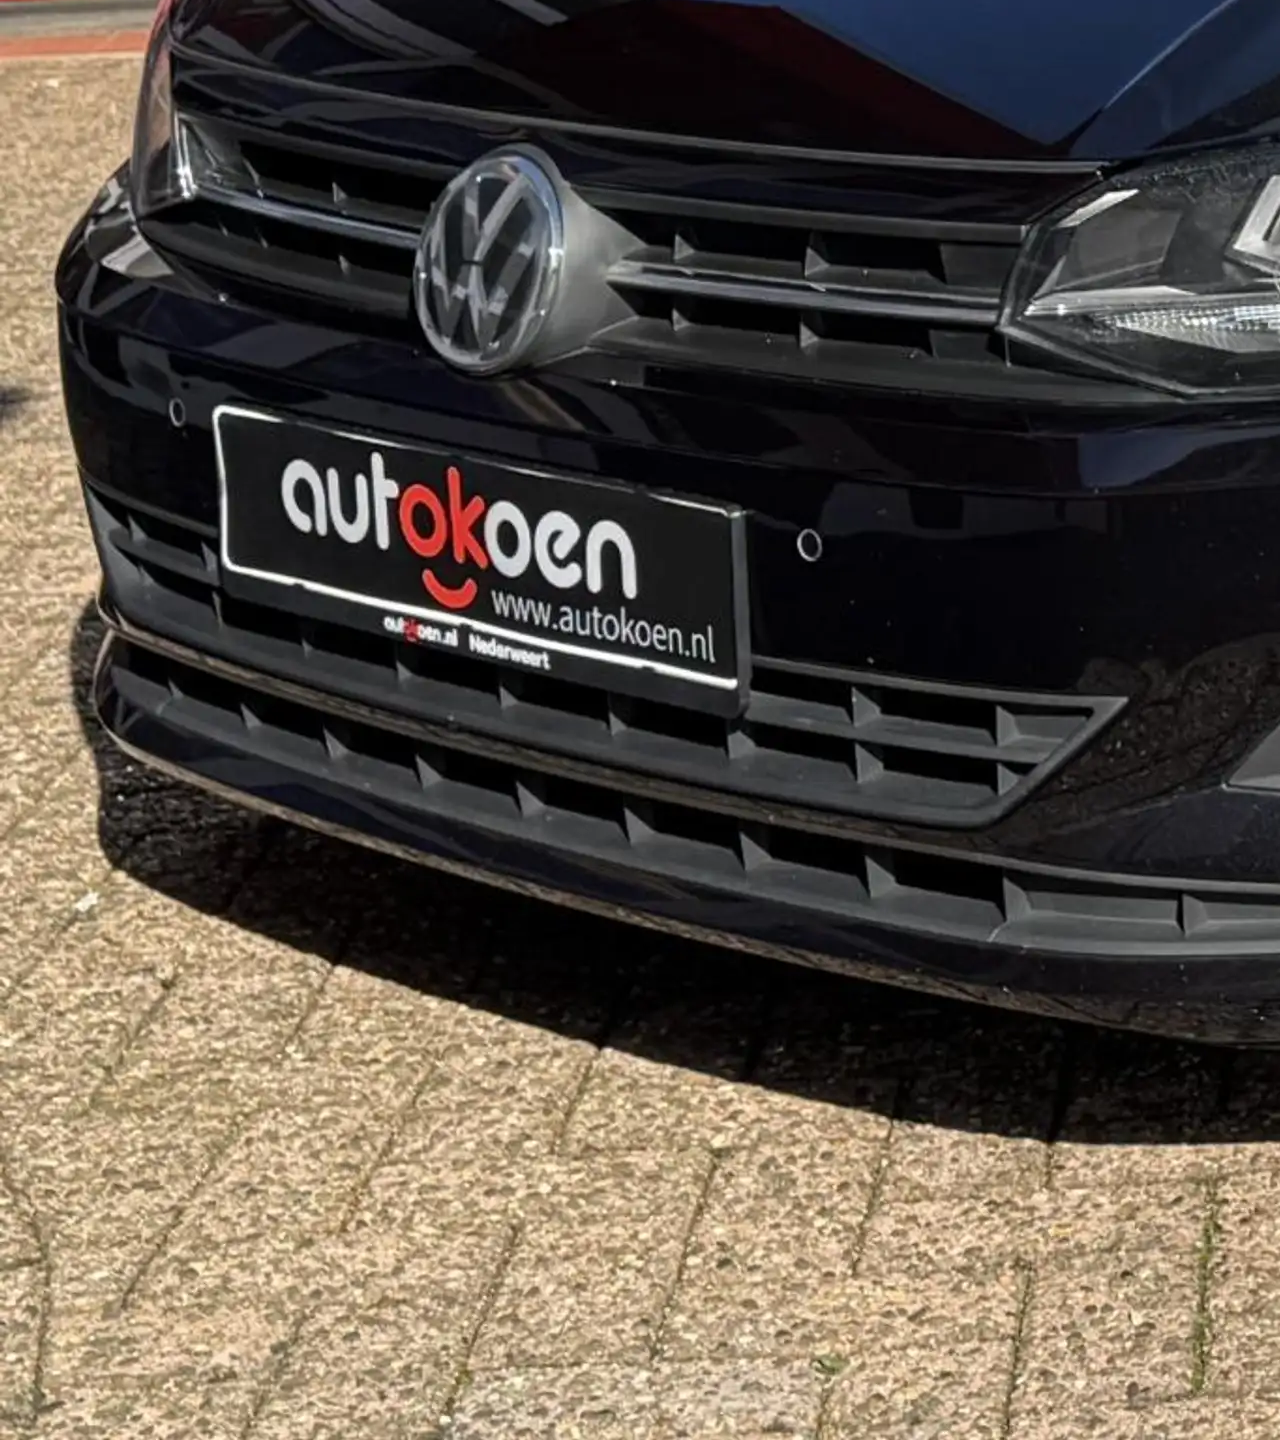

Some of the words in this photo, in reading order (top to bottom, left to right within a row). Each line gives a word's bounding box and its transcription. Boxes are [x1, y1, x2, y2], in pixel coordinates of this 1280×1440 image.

[282, 451, 637, 600] autokoen
[468, 633, 551, 670] Nederweert
[491, 589, 716, 664] www.autokoen.nl
